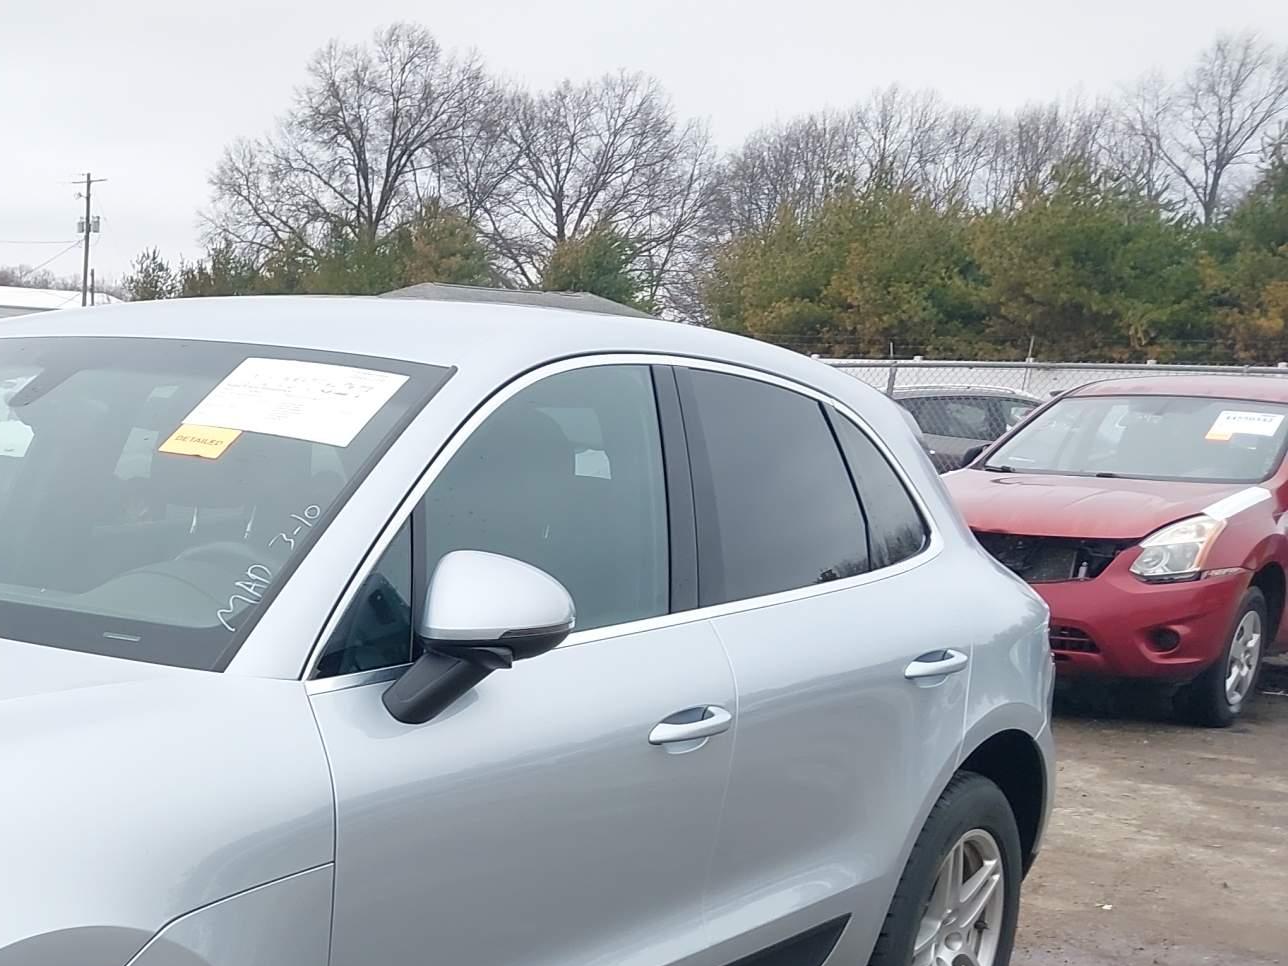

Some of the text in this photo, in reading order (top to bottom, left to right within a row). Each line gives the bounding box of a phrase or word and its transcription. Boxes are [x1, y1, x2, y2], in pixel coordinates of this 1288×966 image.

[174, 434, 224, 446] DETAILED
[216, 504, 321, 632] MAD 3-10
